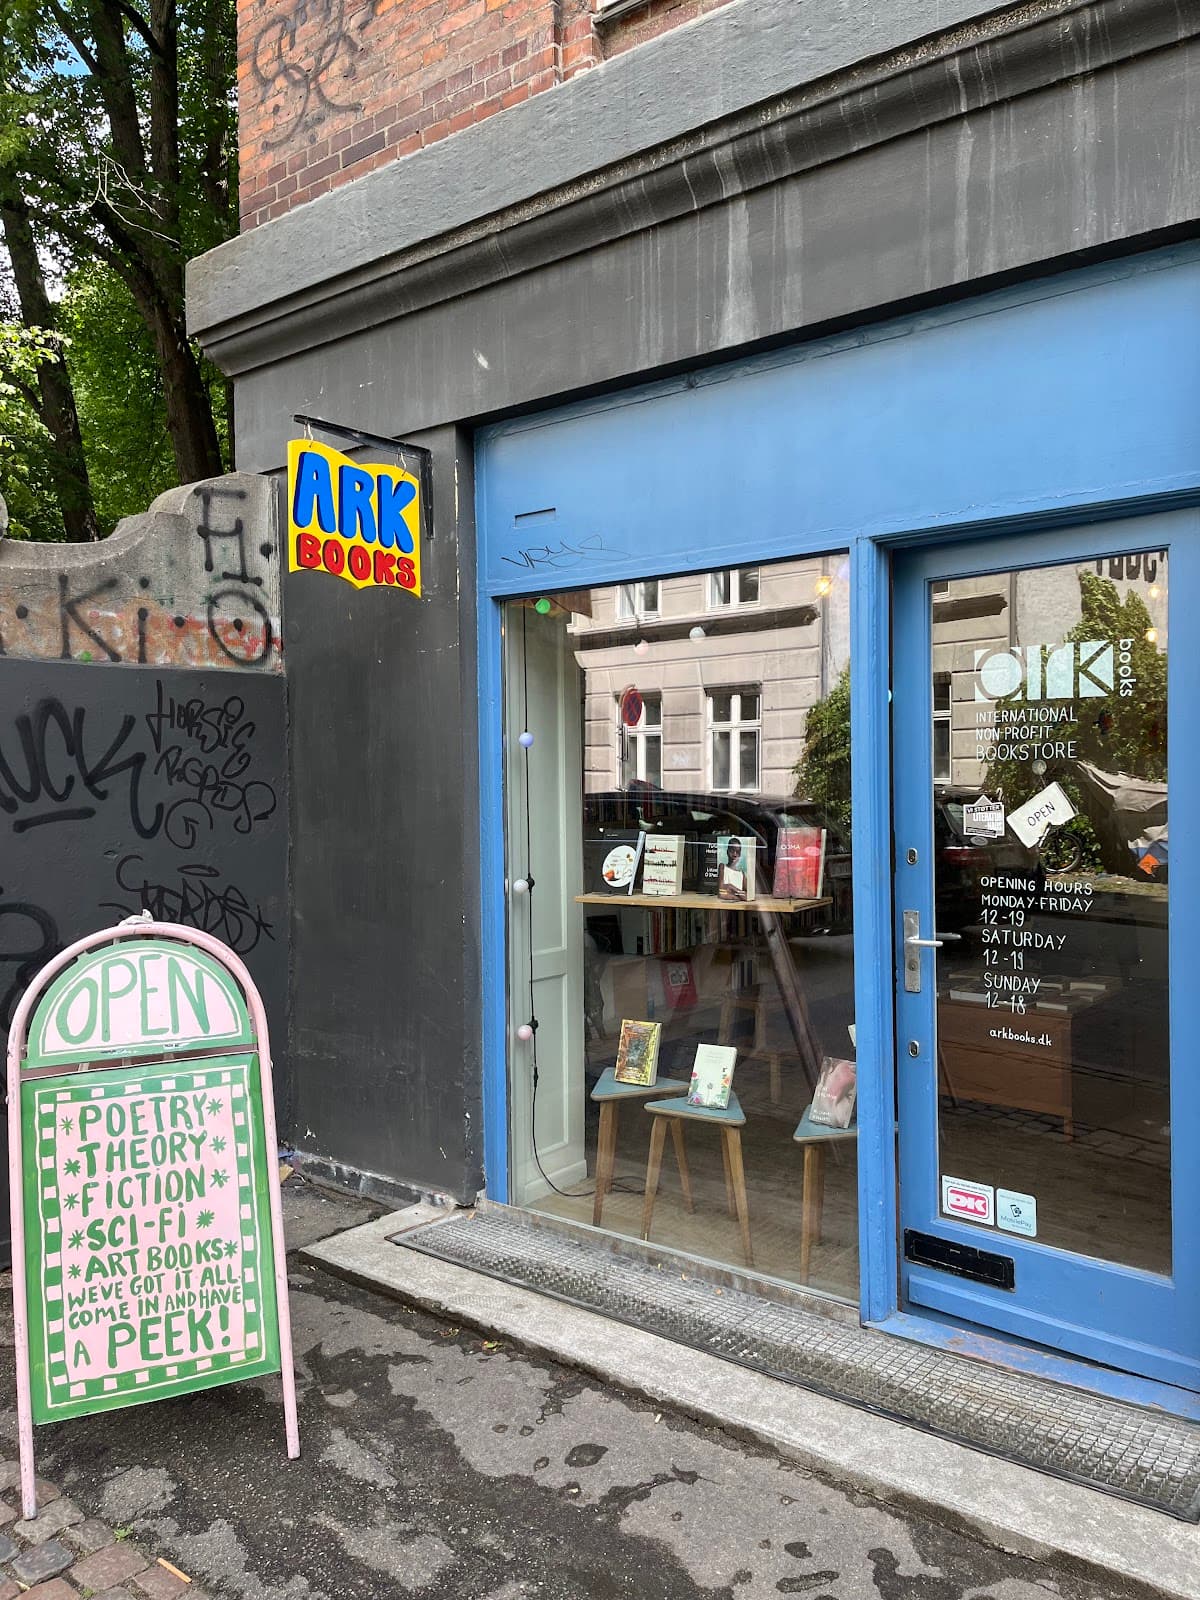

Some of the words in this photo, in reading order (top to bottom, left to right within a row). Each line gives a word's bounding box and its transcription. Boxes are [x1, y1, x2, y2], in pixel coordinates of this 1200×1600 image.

[293, 452, 416, 553] ARK
[296, 533, 416, 589] BOOKS
[1119, 639, 1136, 697] books
[975, 706, 1079, 724] INTERNATIONAL
[975, 740, 1079, 761] BOOKSTORE
[1027, 801, 1056, 827] OPEN
[980, 876, 1036, 891] OPENING
[1044, 881, 1093, 895] HOURS
[981, 894, 1093, 912] MONDAY-FRIDAY
[981, 929, 1067, 950] SATURDAY
[55, 954, 210, 1044] OPEN
[984, 972, 1041, 994] SUNDAY
[989, 1027, 1052, 1046] arkbooks.dk
[78, 1092, 207, 1141] POETRY
[77, 1130, 207, 1178] THEORY
[82, 1164, 206, 1217] FICTION
[87, 1202, 185, 1250] SCI-FI
[84, 1249, 141, 1282] ART
[147, 1238, 223, 1272] BOOKS
[130, 1273, 165, 1296] GOT
[175, 1267, 192, 1290] IT
[68, 1302, 131, 1329] COME
[138, 1295, 159, 1317] IN
[165, 1291, 196, 1312] AND
[199, 1286, 241, 1309] HAVE
[73, 1340, 91, 1368] A
[107, 1306, 231, 1369] PEEK!
